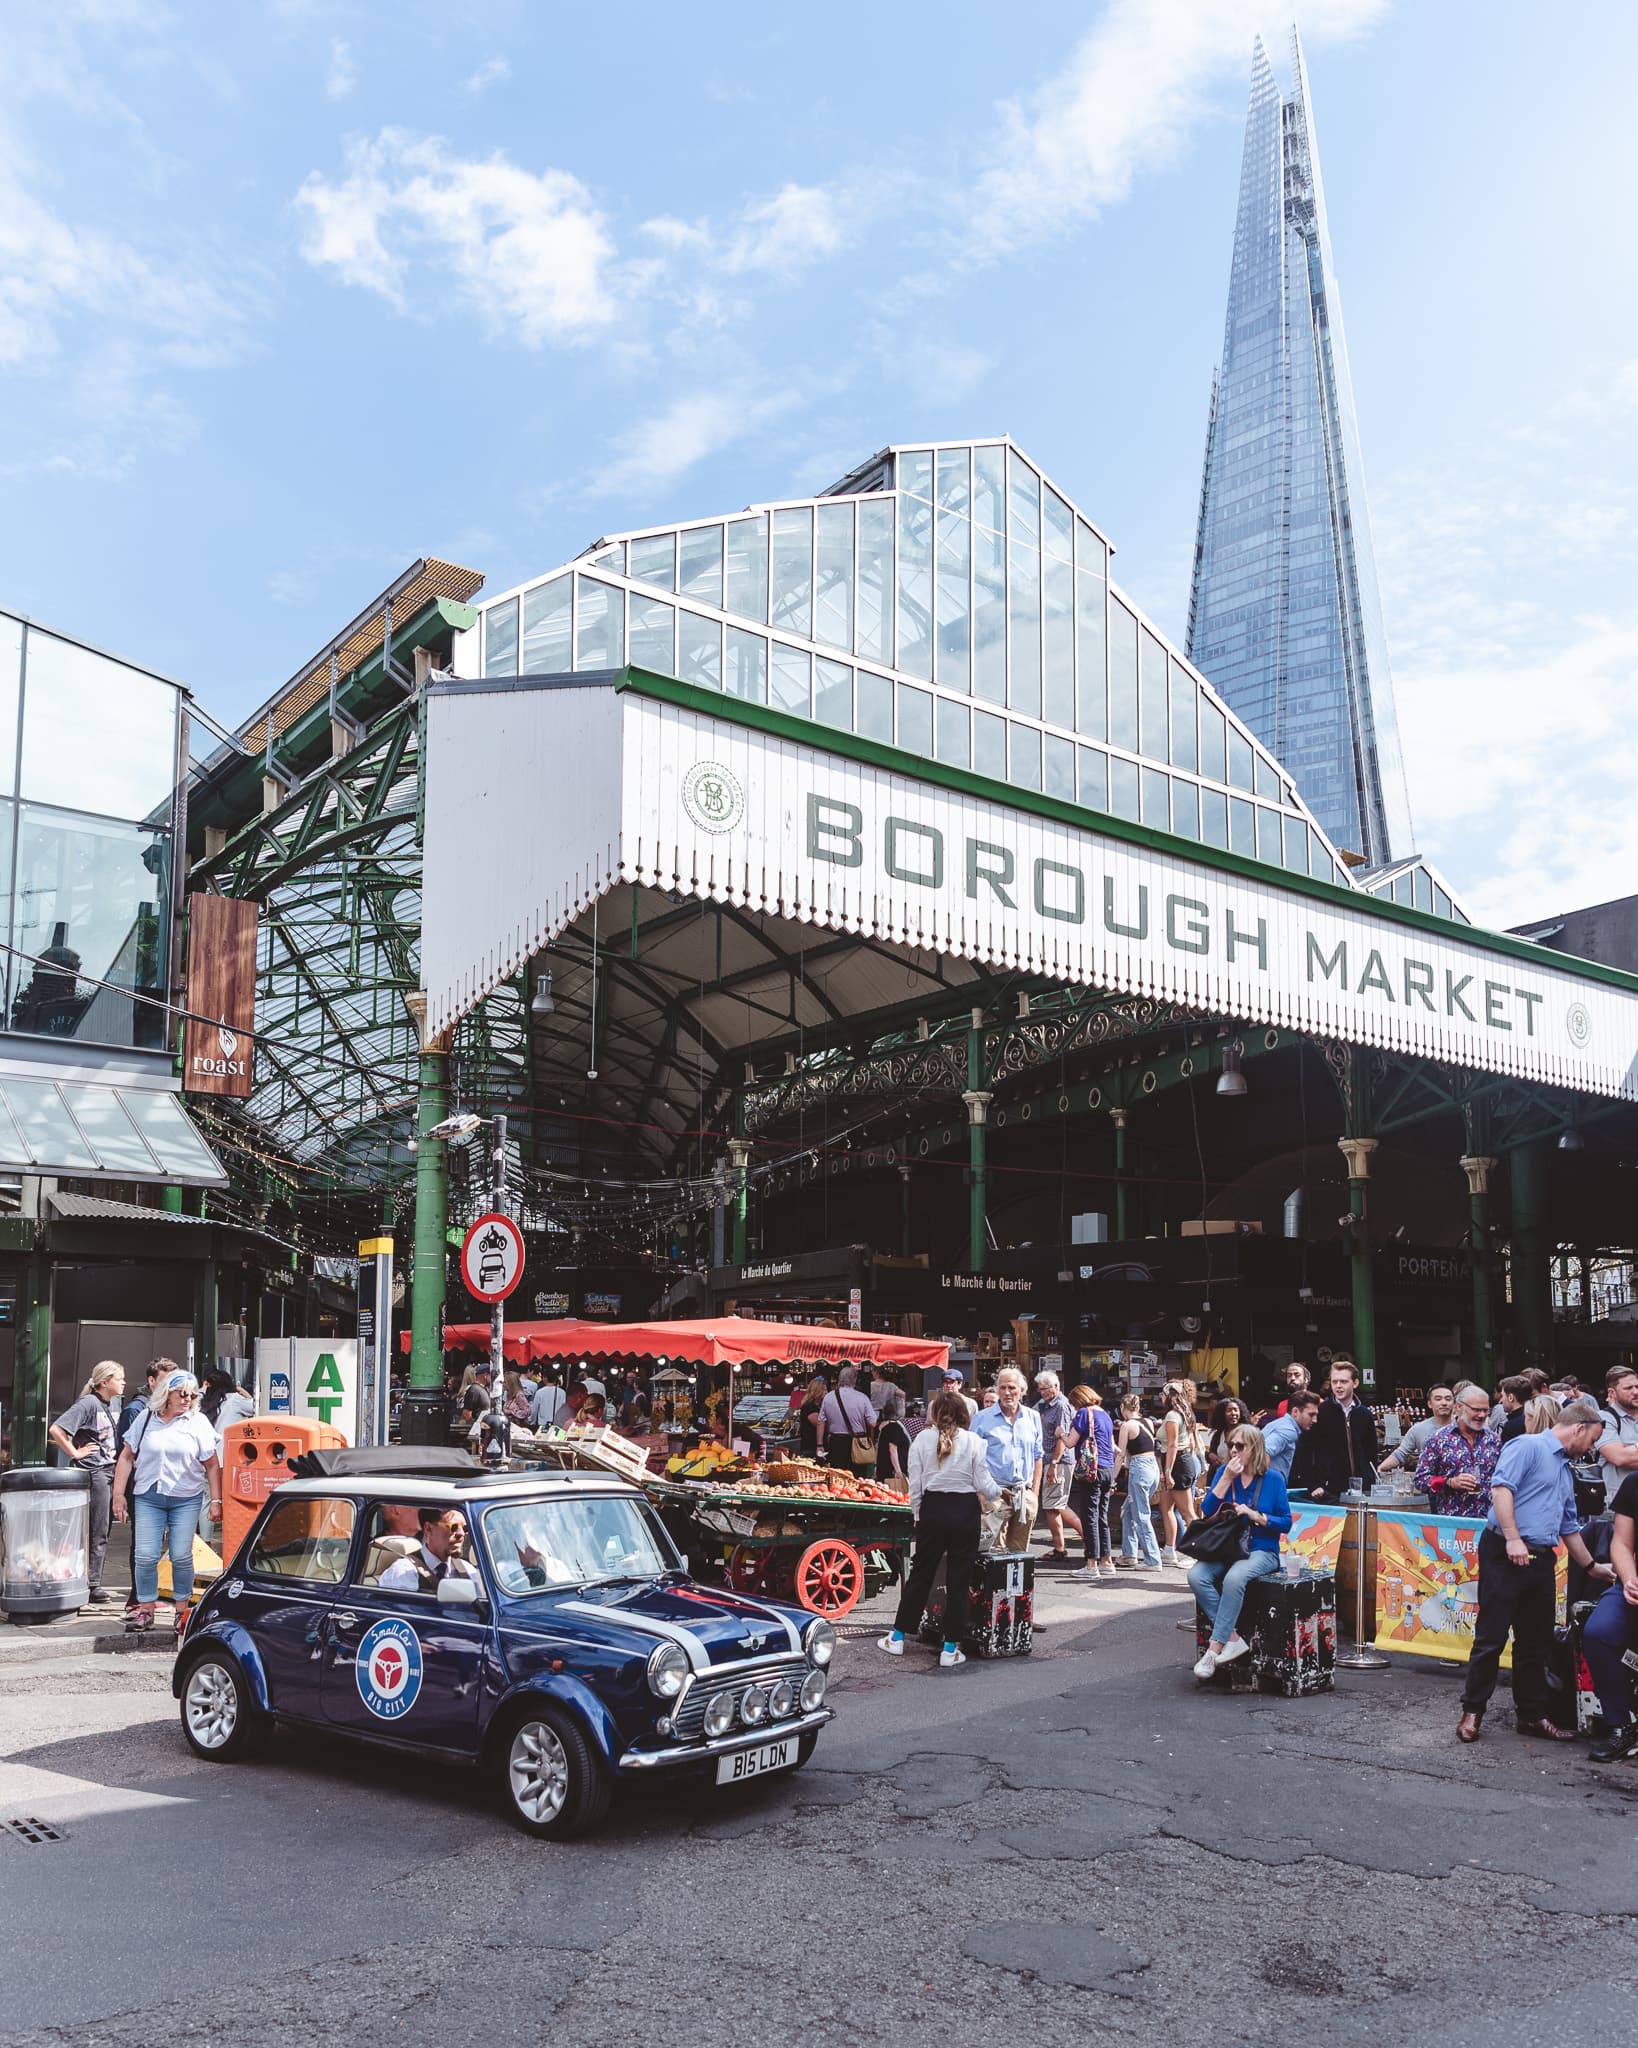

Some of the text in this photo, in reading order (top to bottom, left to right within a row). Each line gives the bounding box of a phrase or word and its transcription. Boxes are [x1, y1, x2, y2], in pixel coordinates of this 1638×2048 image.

[806, 793, 1544, 1038] BOROUGH MARKET
[193, 1057, 246, 1076] roast
[741, 1261, 792, 1279] Le Marché du Quartier
[941, 1274, 1032, 1292] Le Marché du Quartier
[786, 1340, 882, 1360] BOROUGH MARKET
[371, 1623, 413, 1647] Small Car
[367, 1691, 406, 1714] BIG CITY
[733, 1743, 788, 1779] B15 LDN
